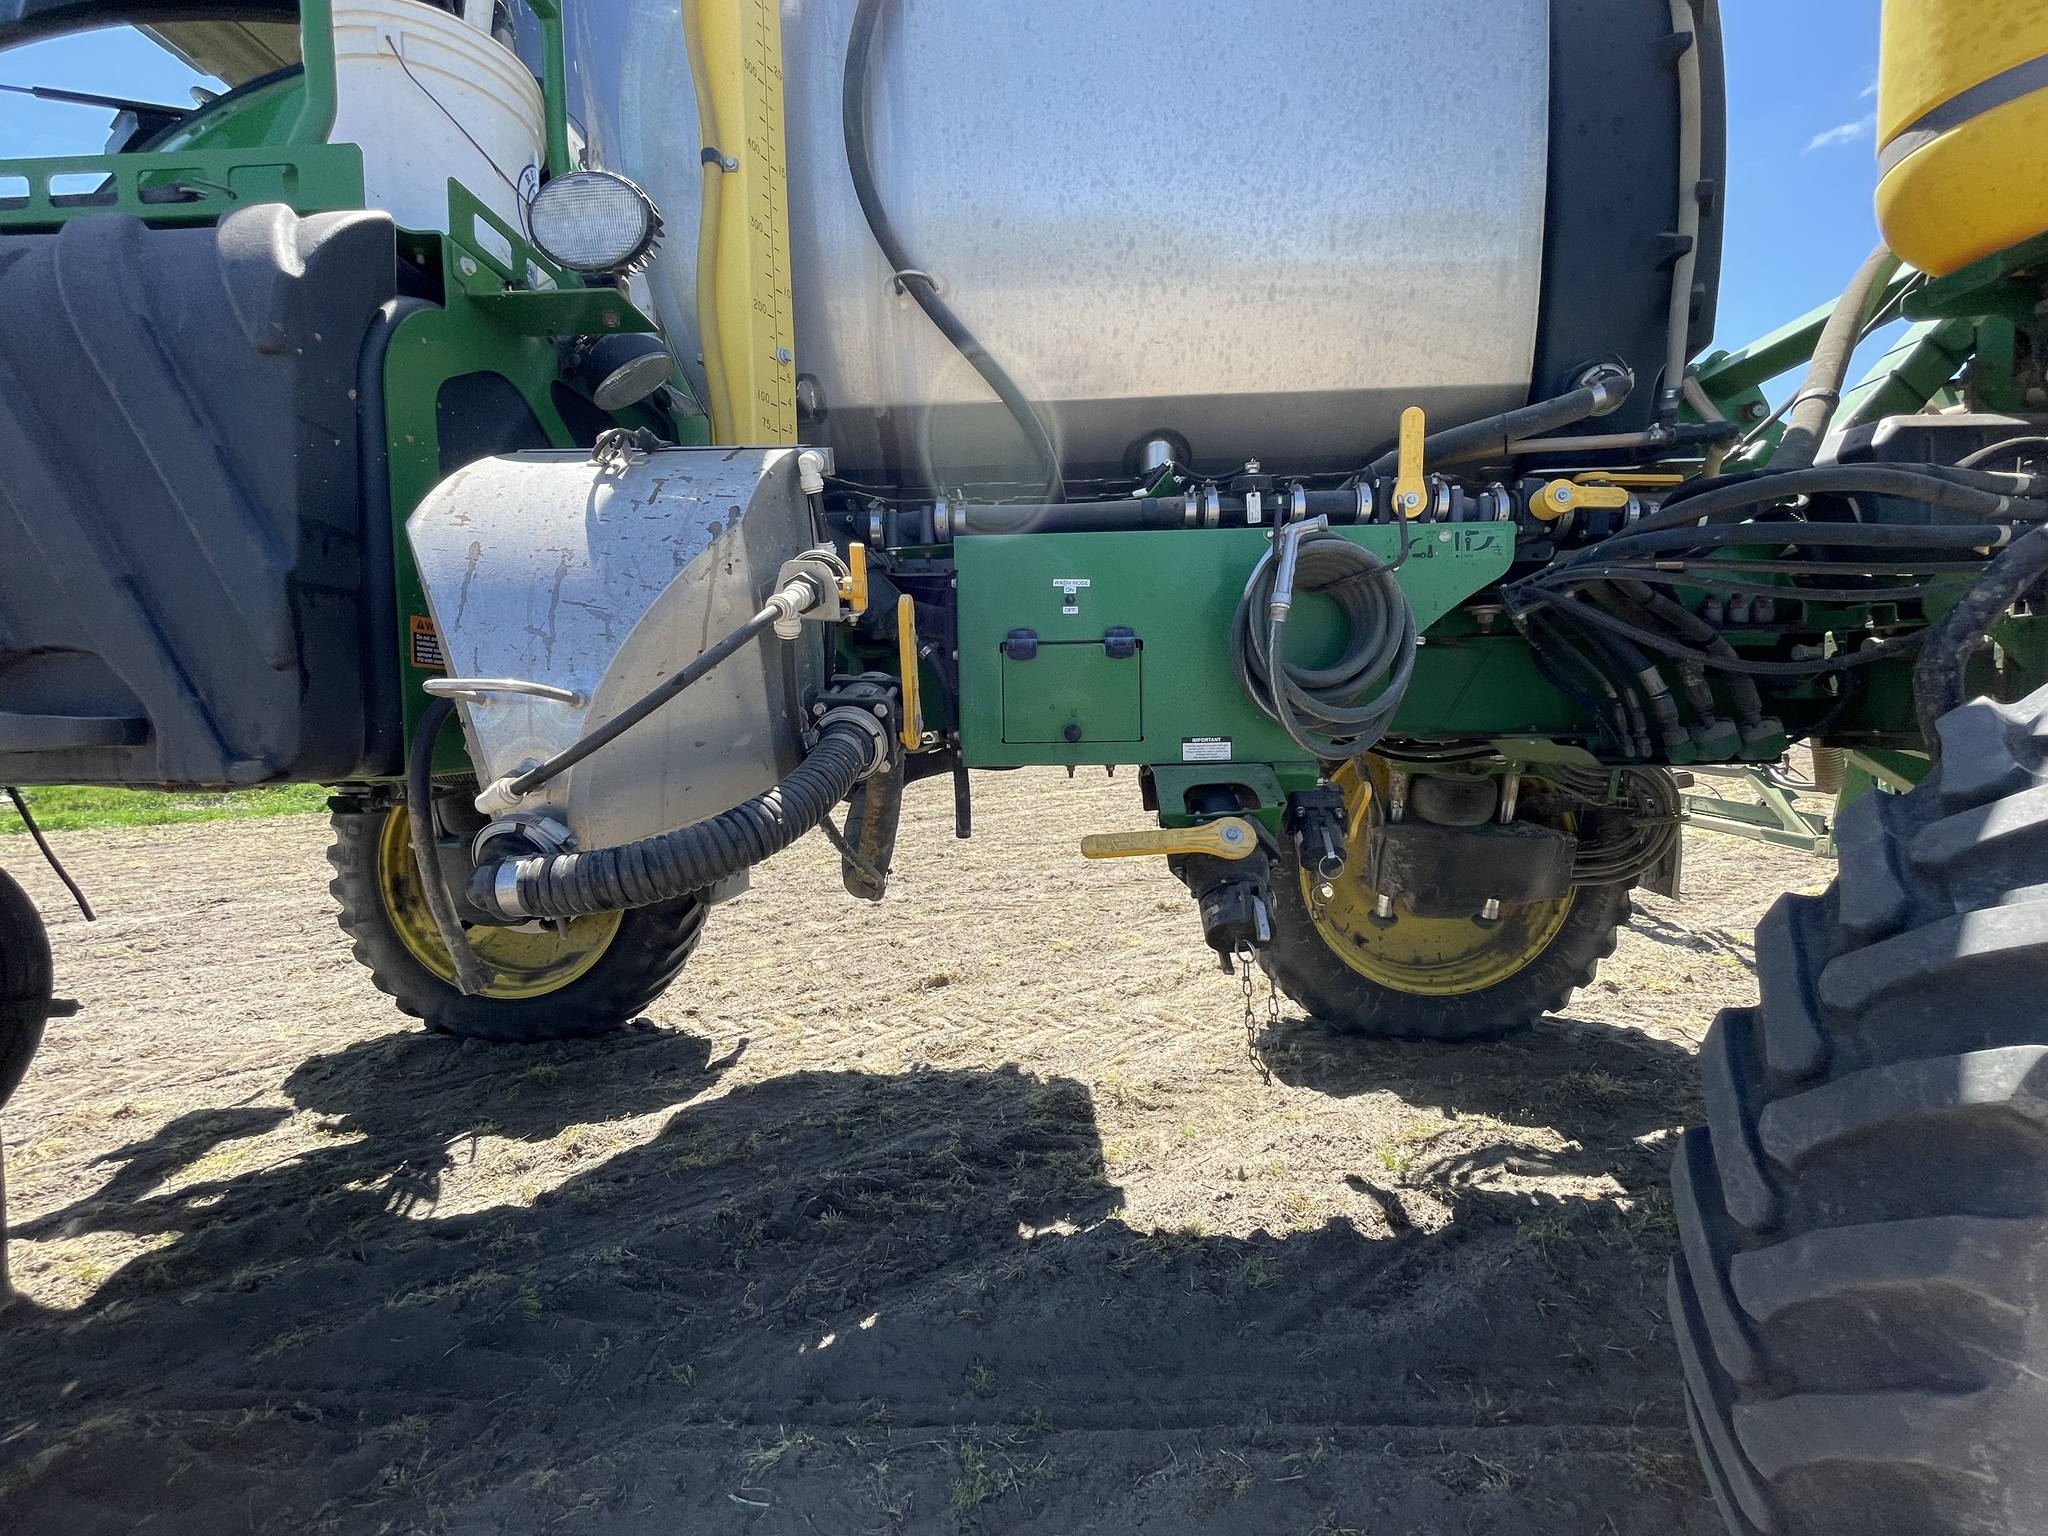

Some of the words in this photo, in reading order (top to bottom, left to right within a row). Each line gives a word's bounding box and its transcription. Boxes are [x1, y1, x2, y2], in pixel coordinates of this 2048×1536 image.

[744, 57, 757, 78] 500
[773, 65, 783, 81] 20
[747, 137, 760, 155] 400
[778, 165, 786, 179] 15
[750, 215, 763, 233] 300
[783, 286, 791, 299] 10
[753, 298, 767, 314] 200
[786, 373, 792, 384] 5
[757, 389, 770, 404] 100
[787, 398, 792, 408] 4
[761, 417, 771, 430] 75
[789, 424, 793, 435] 3
